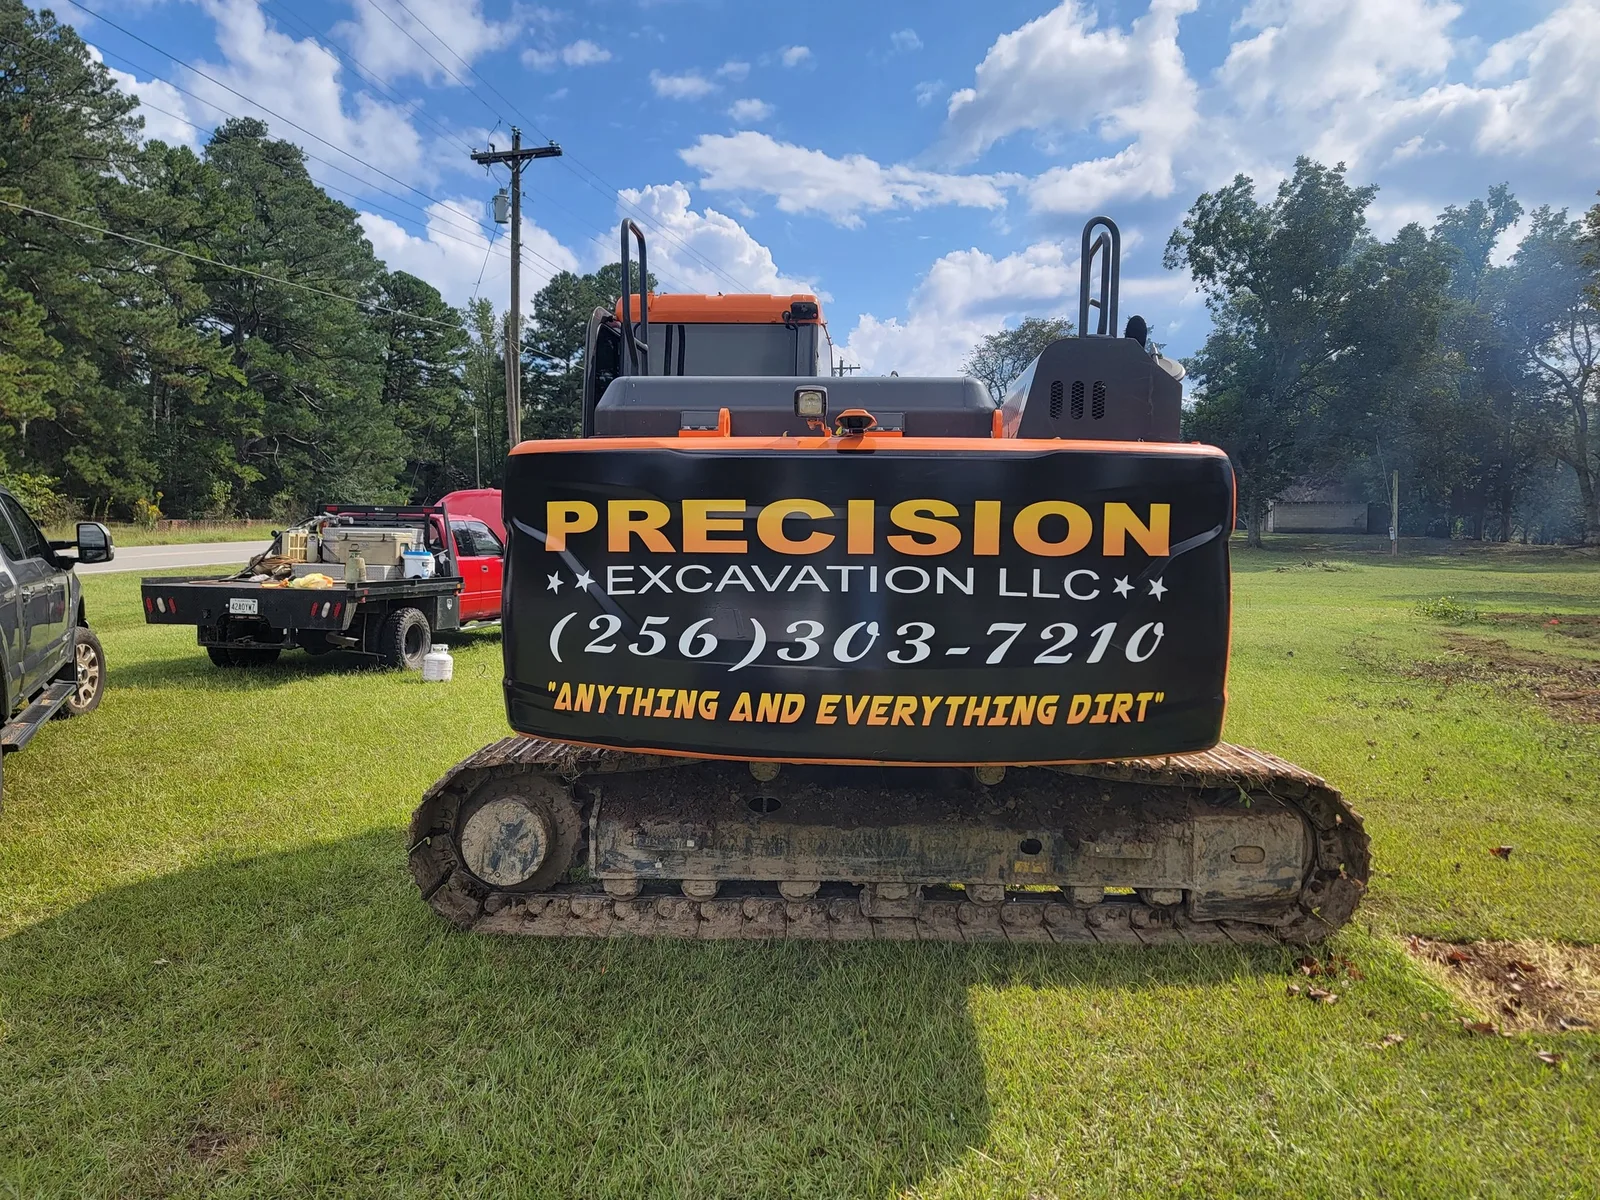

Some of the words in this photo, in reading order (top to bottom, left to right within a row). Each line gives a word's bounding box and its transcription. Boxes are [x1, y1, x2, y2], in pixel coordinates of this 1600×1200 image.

[546, 499, 1170, 556] PRECISION
[607, 565, 974, 598] EXCAVATION
[1000, 567, 1100, 600] LLC
[548, 682, 721, 721] "ANYTHING
[729, 692, 805, 724] AND
[816, 694, 1060, 726] EVERYTHING
[1067, 692, 1165, 724] DIRT"
